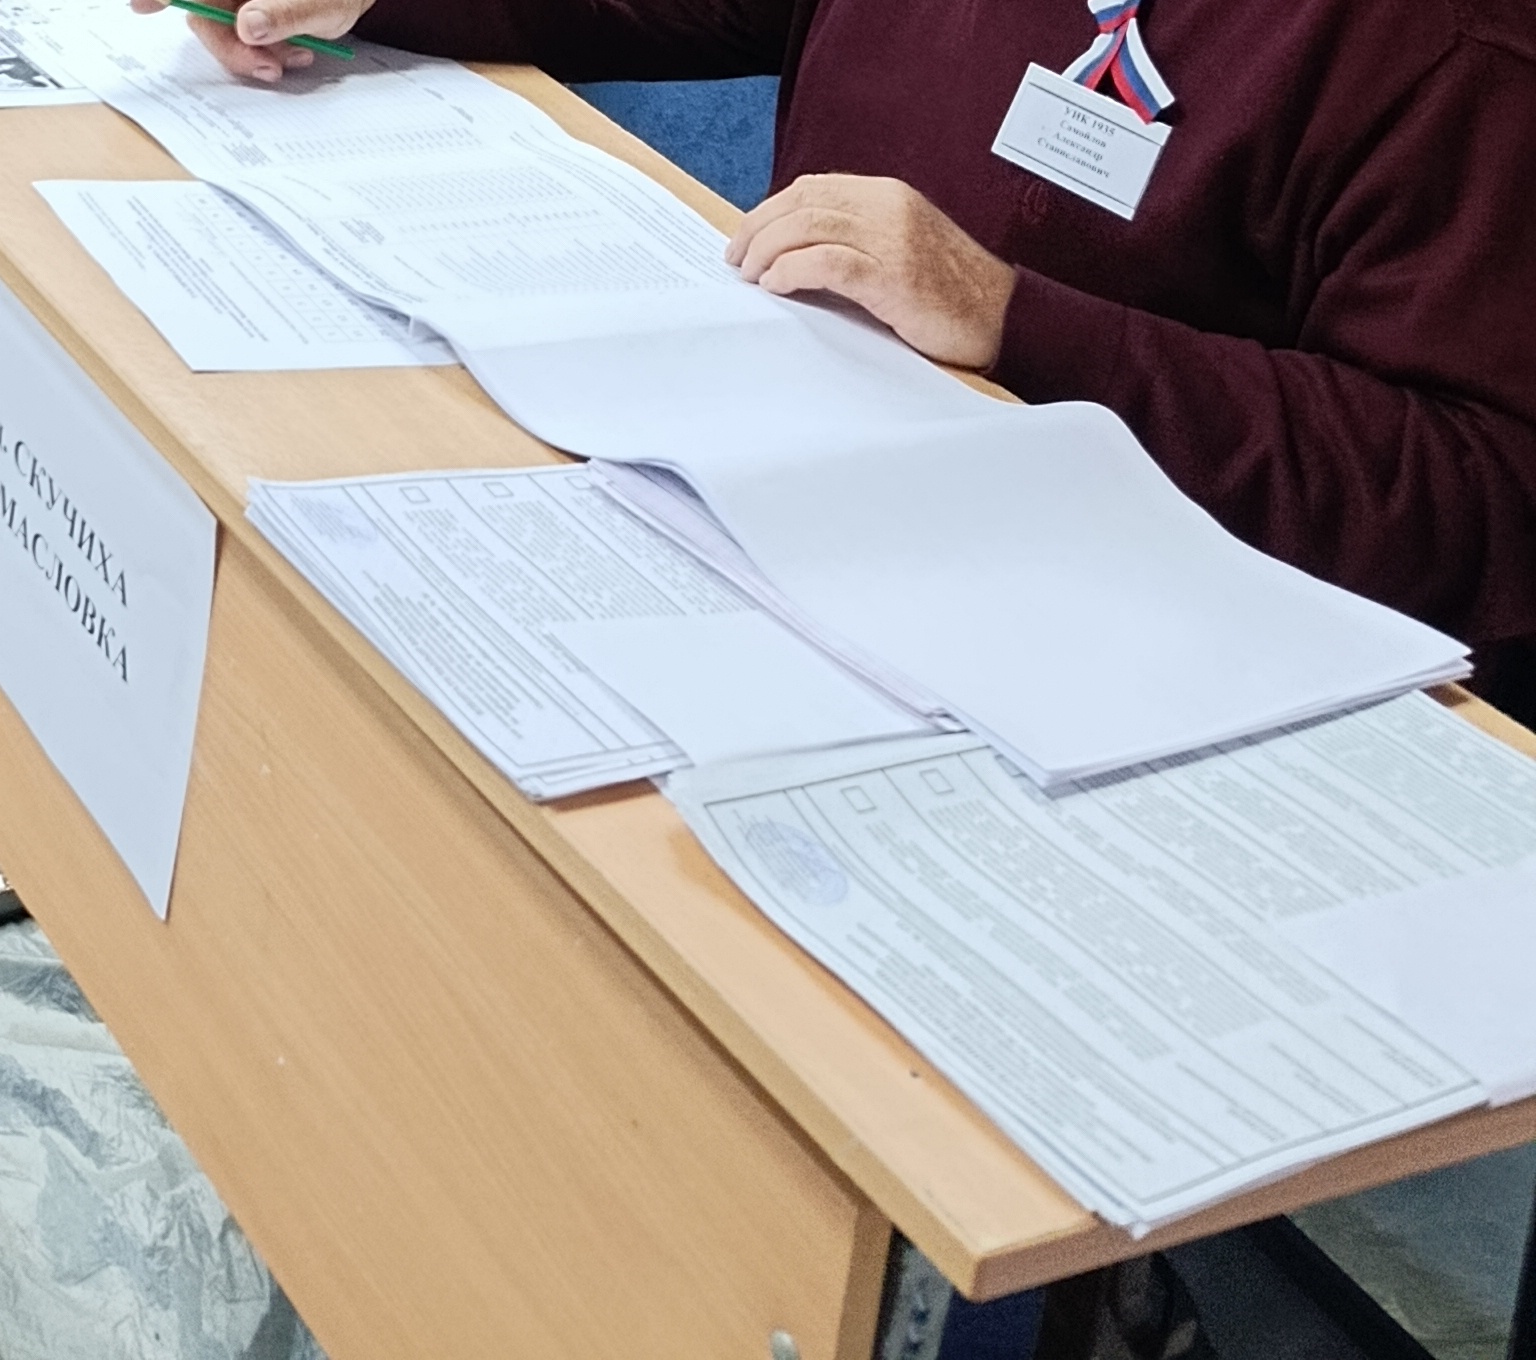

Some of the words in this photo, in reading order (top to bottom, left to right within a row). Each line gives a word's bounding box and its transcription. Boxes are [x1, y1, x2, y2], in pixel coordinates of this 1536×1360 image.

[1092, 120, 1116, 137] 1935
[1053, 132, 1103, 161] Александр
[13, 440, 129, 608] СКУЧИХА
